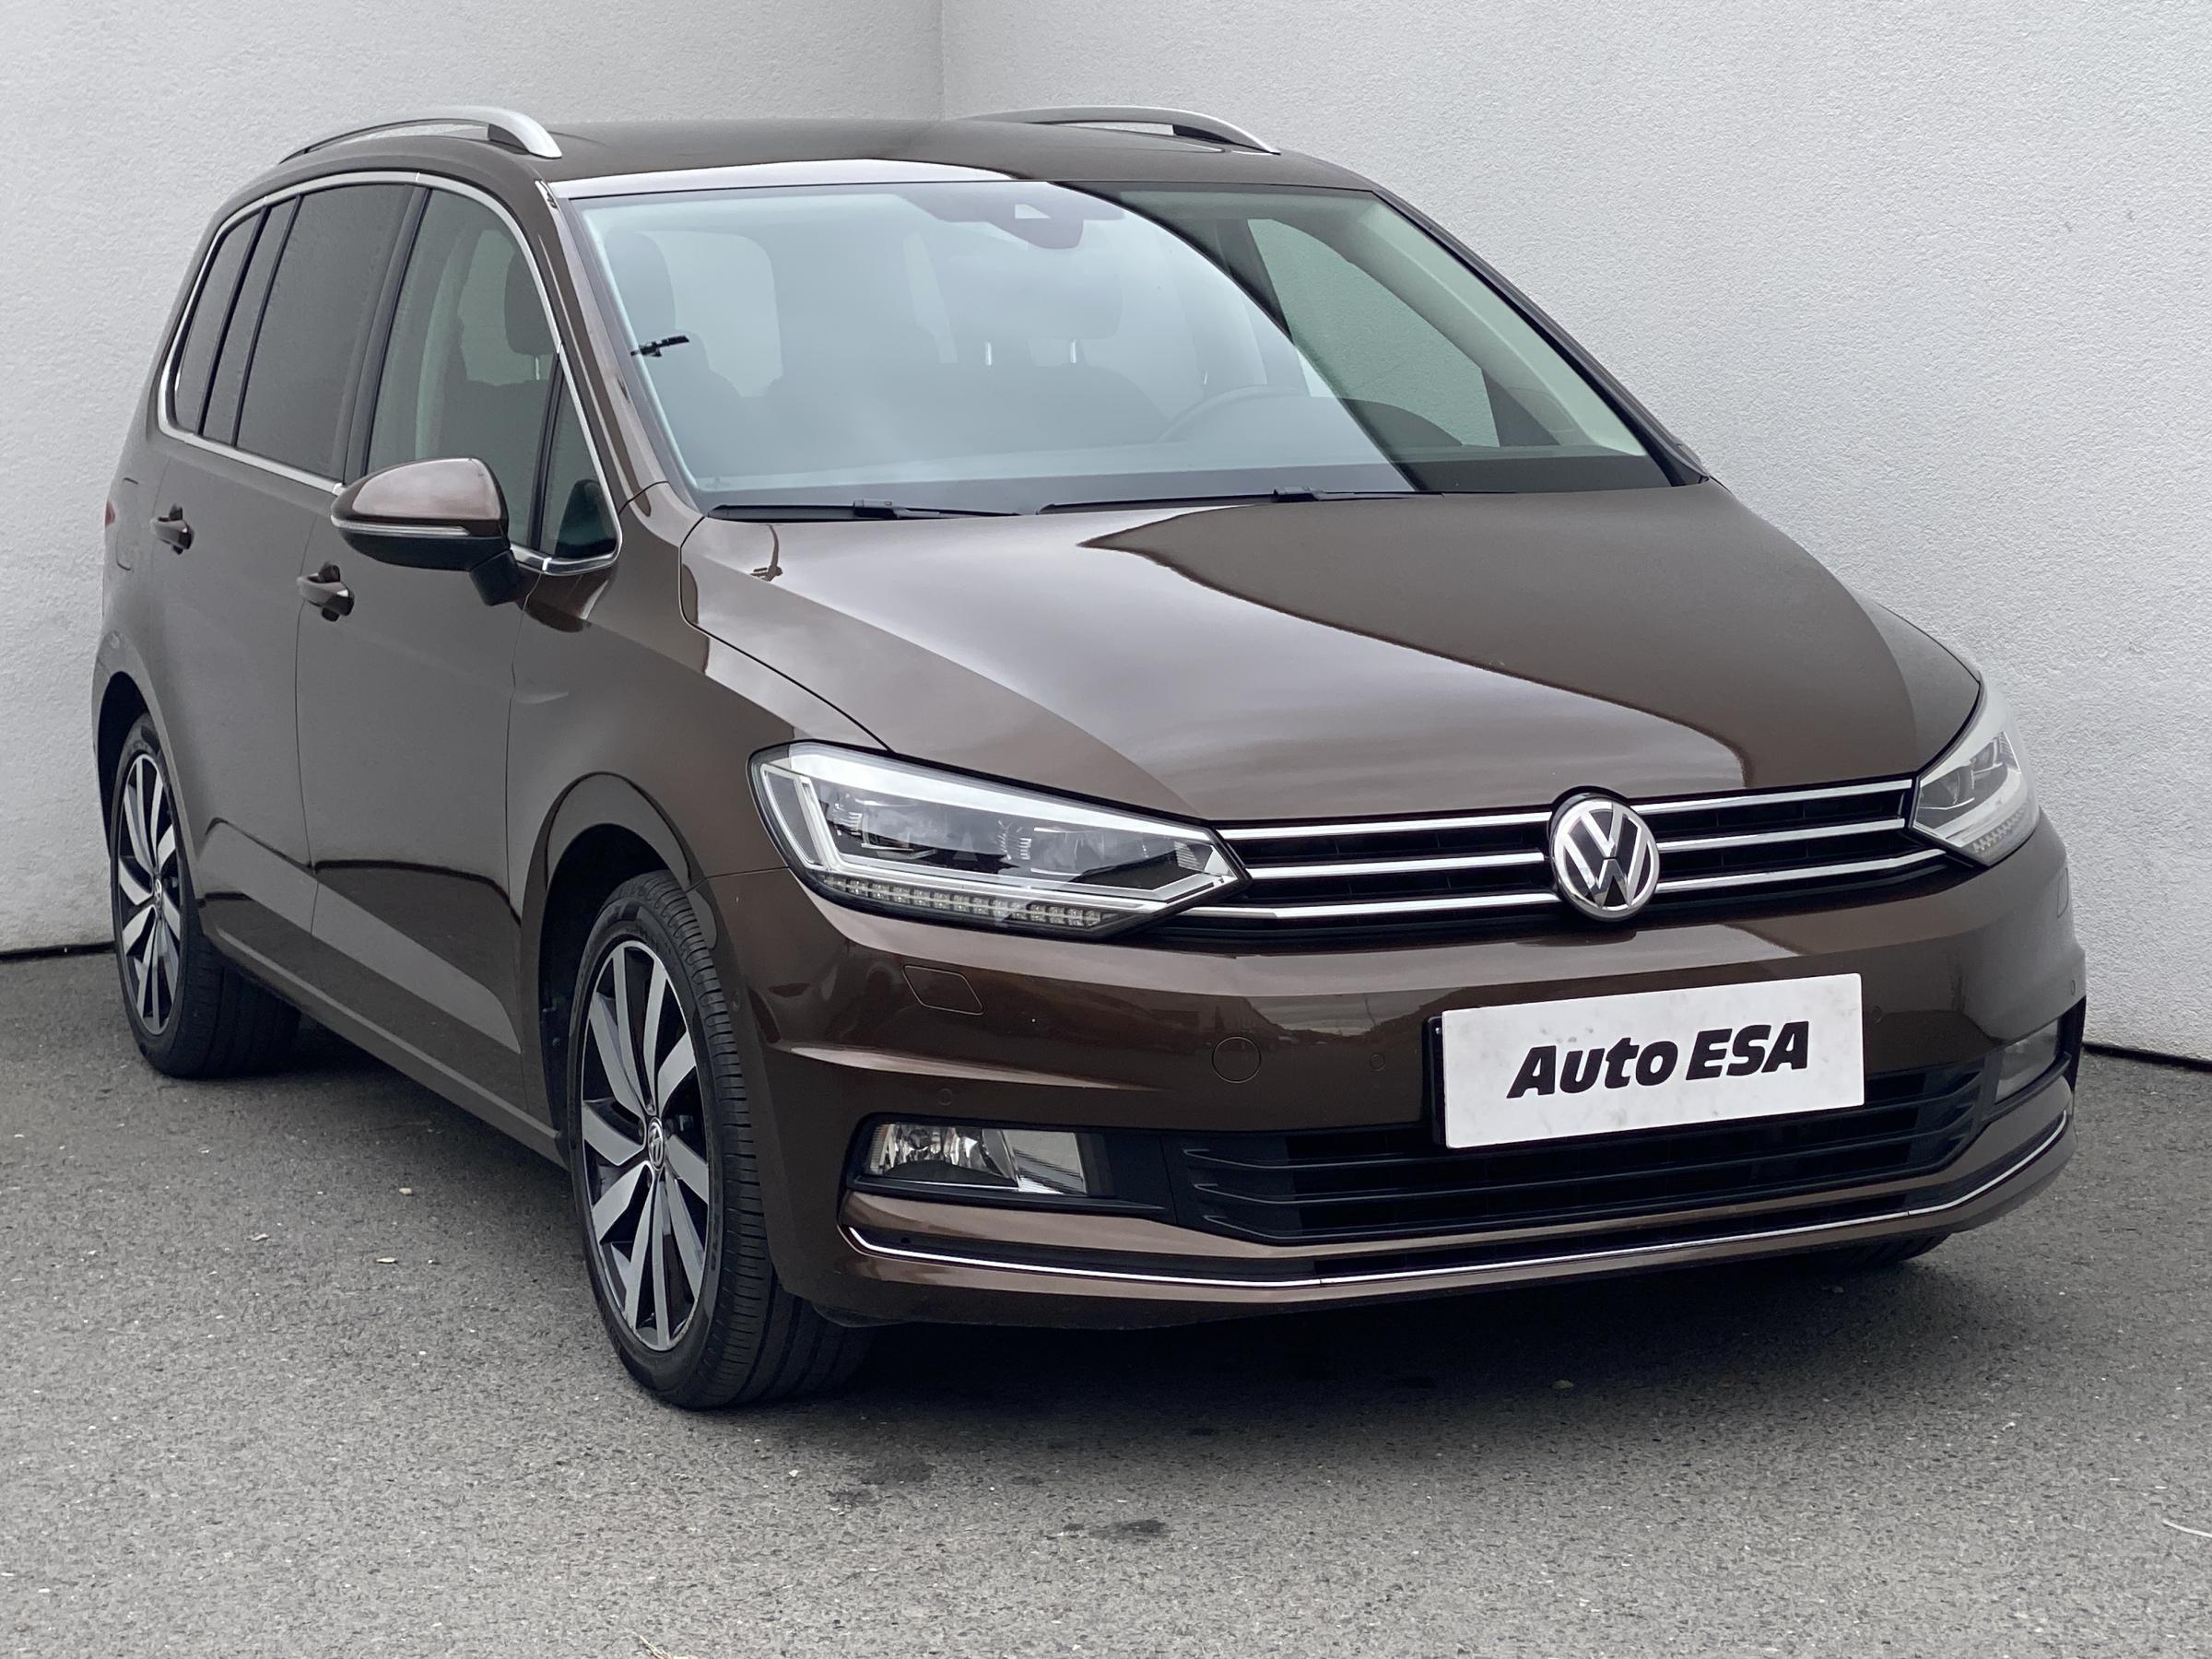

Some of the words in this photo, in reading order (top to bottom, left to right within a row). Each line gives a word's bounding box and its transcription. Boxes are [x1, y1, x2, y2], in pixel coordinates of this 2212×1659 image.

[1555, 800, 1656, 916] VW
[1506, 1037, 1679, 1099] Auto
[1686, 1020, 1810, 1081] ESA
